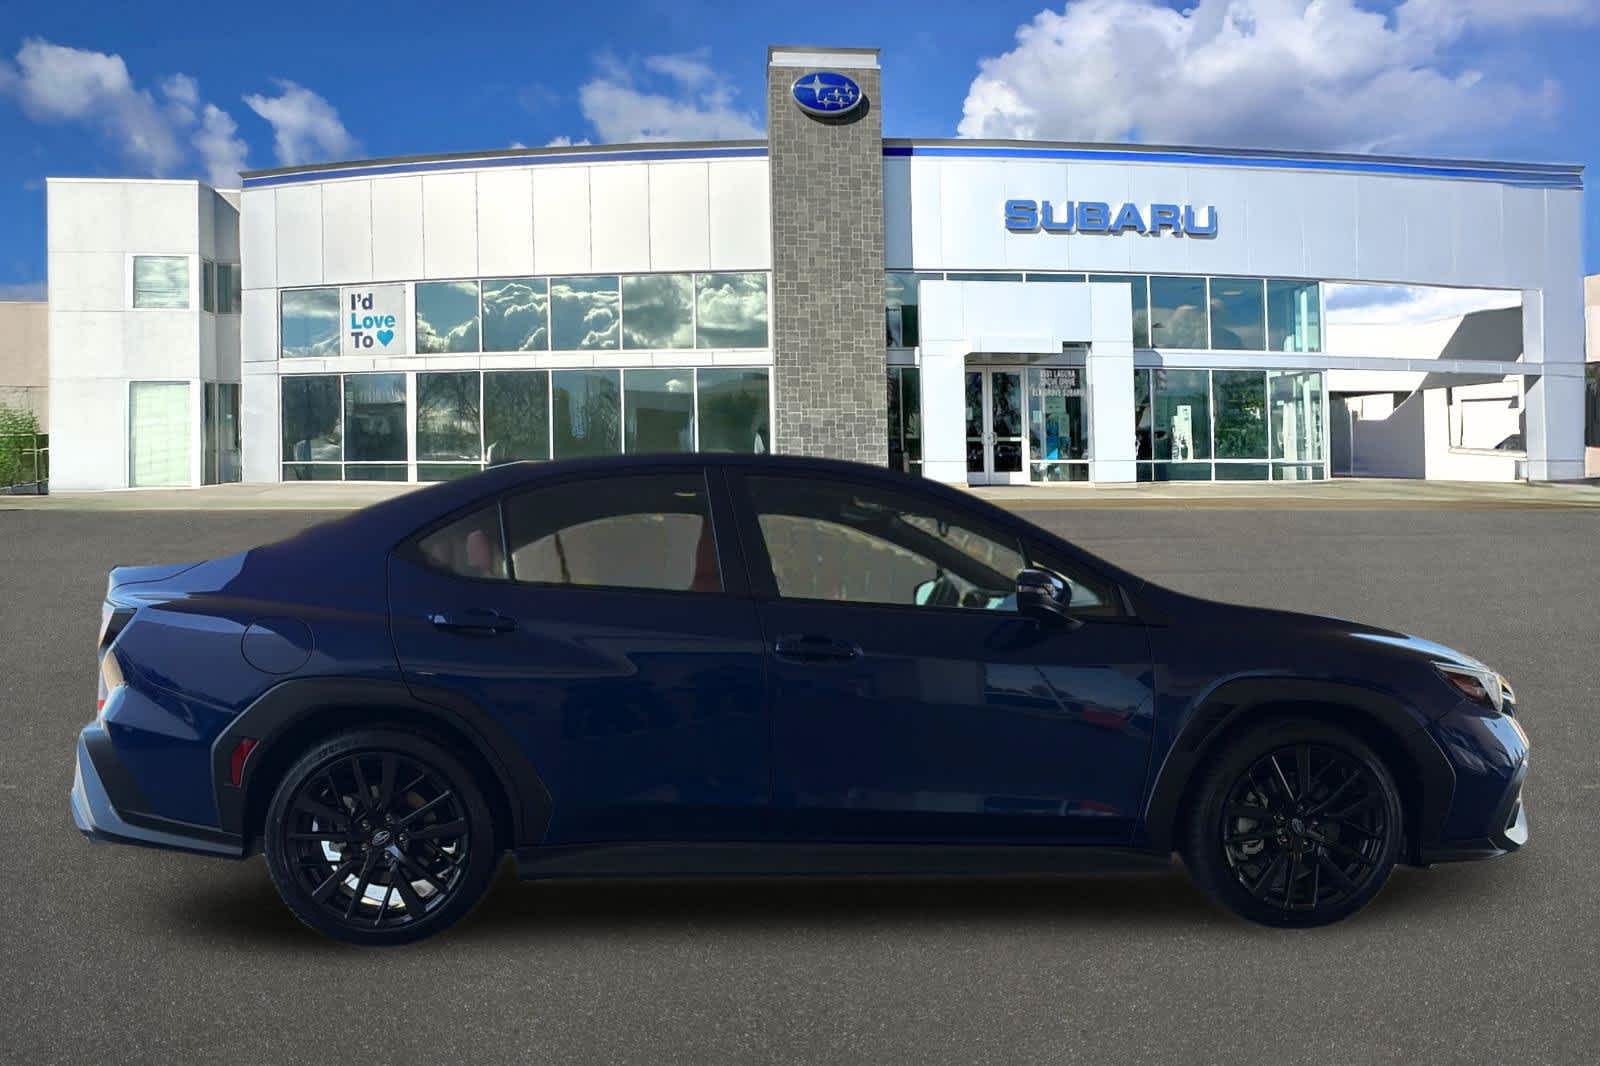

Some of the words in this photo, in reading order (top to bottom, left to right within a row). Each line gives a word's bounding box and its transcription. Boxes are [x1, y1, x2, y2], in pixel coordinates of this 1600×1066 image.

[1005, 200, 1218, 238] SUBARU
[351, 312, 396, 329] Love
[351, 331, 374, 348] To
